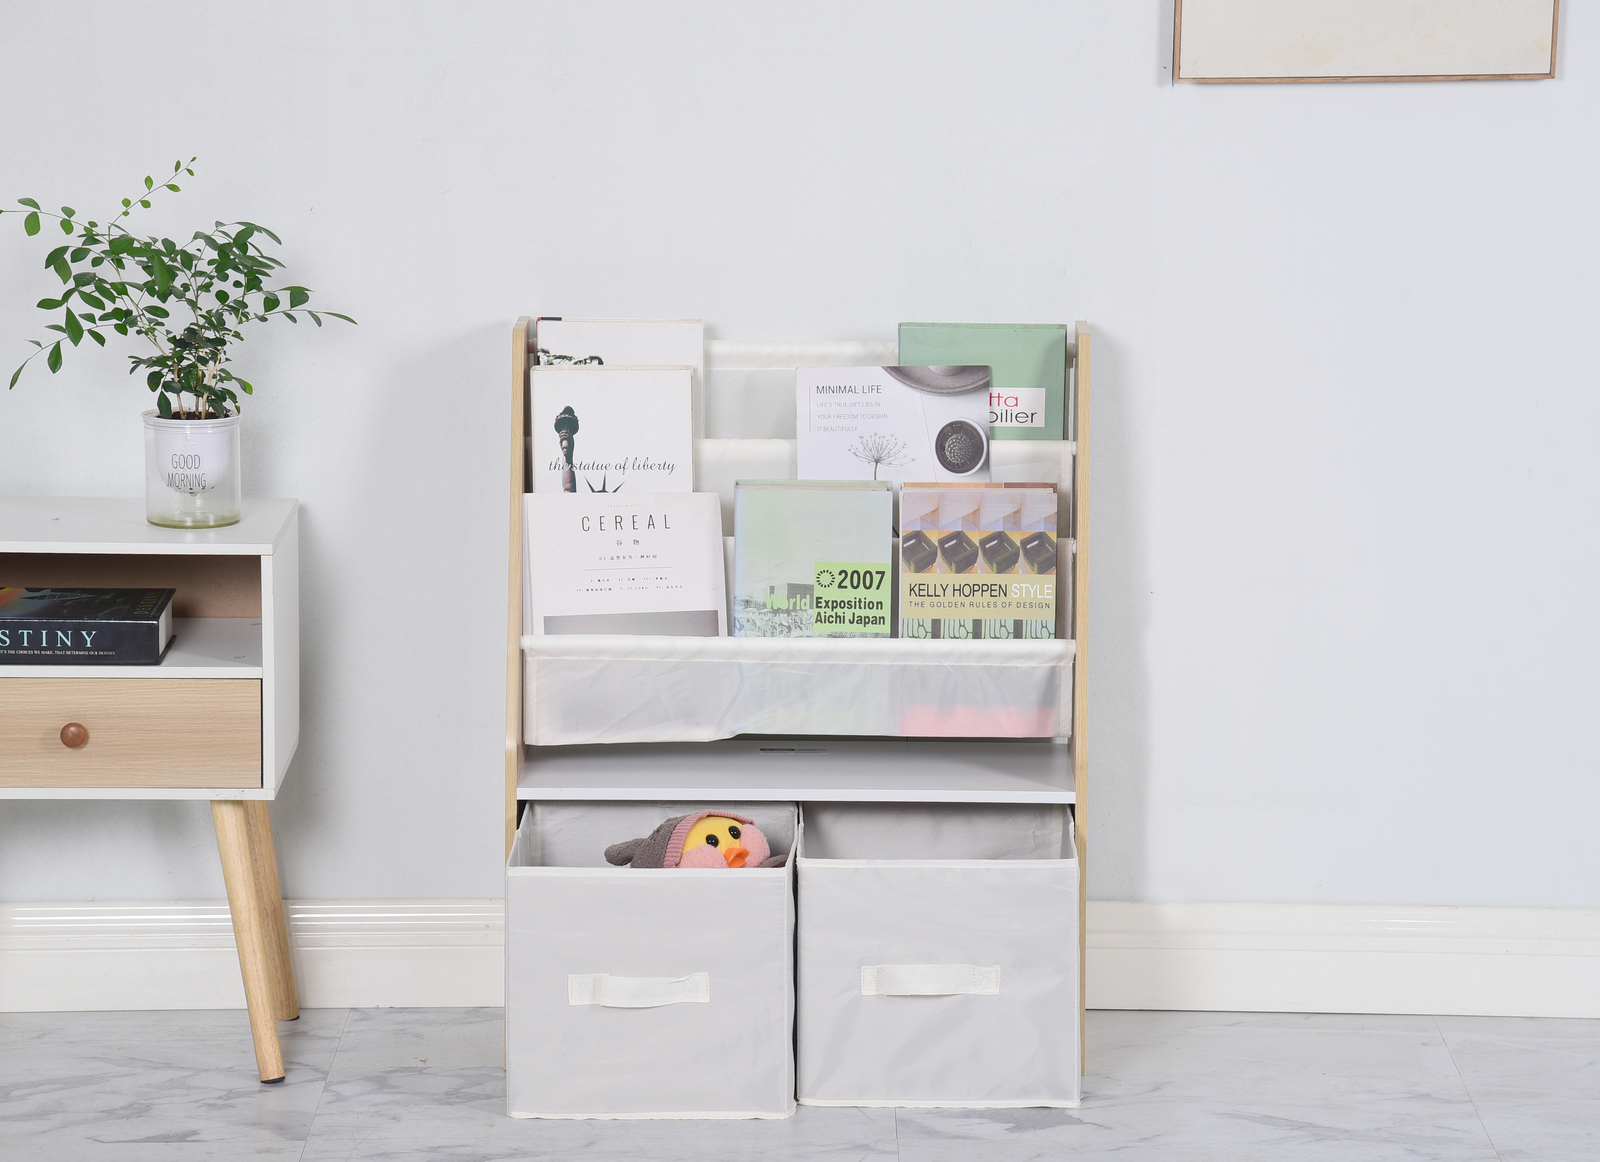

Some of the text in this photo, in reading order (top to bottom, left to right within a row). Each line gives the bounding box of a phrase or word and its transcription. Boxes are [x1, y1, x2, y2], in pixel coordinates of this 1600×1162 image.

[816, 384, 882, 394] MINIMAL LIFE
[171, 453, 201, 470] GOOD
[549, 457, 677, 475] the statue of liberty
[167, 472, 207, 488] MORNING
[581, 514, 671, 532] CEREAL
[837, 569, 886, 591] 2007
[909, 583, 1053, 599] KELLY HOPPEN STYLE
[765, 593, 883, 612] World Exposition
[1016, 601, 1051, 609] DESIGN
[815, 611, 886, 628] Aichi Japan
[0, 629, 97, 648] STINY
